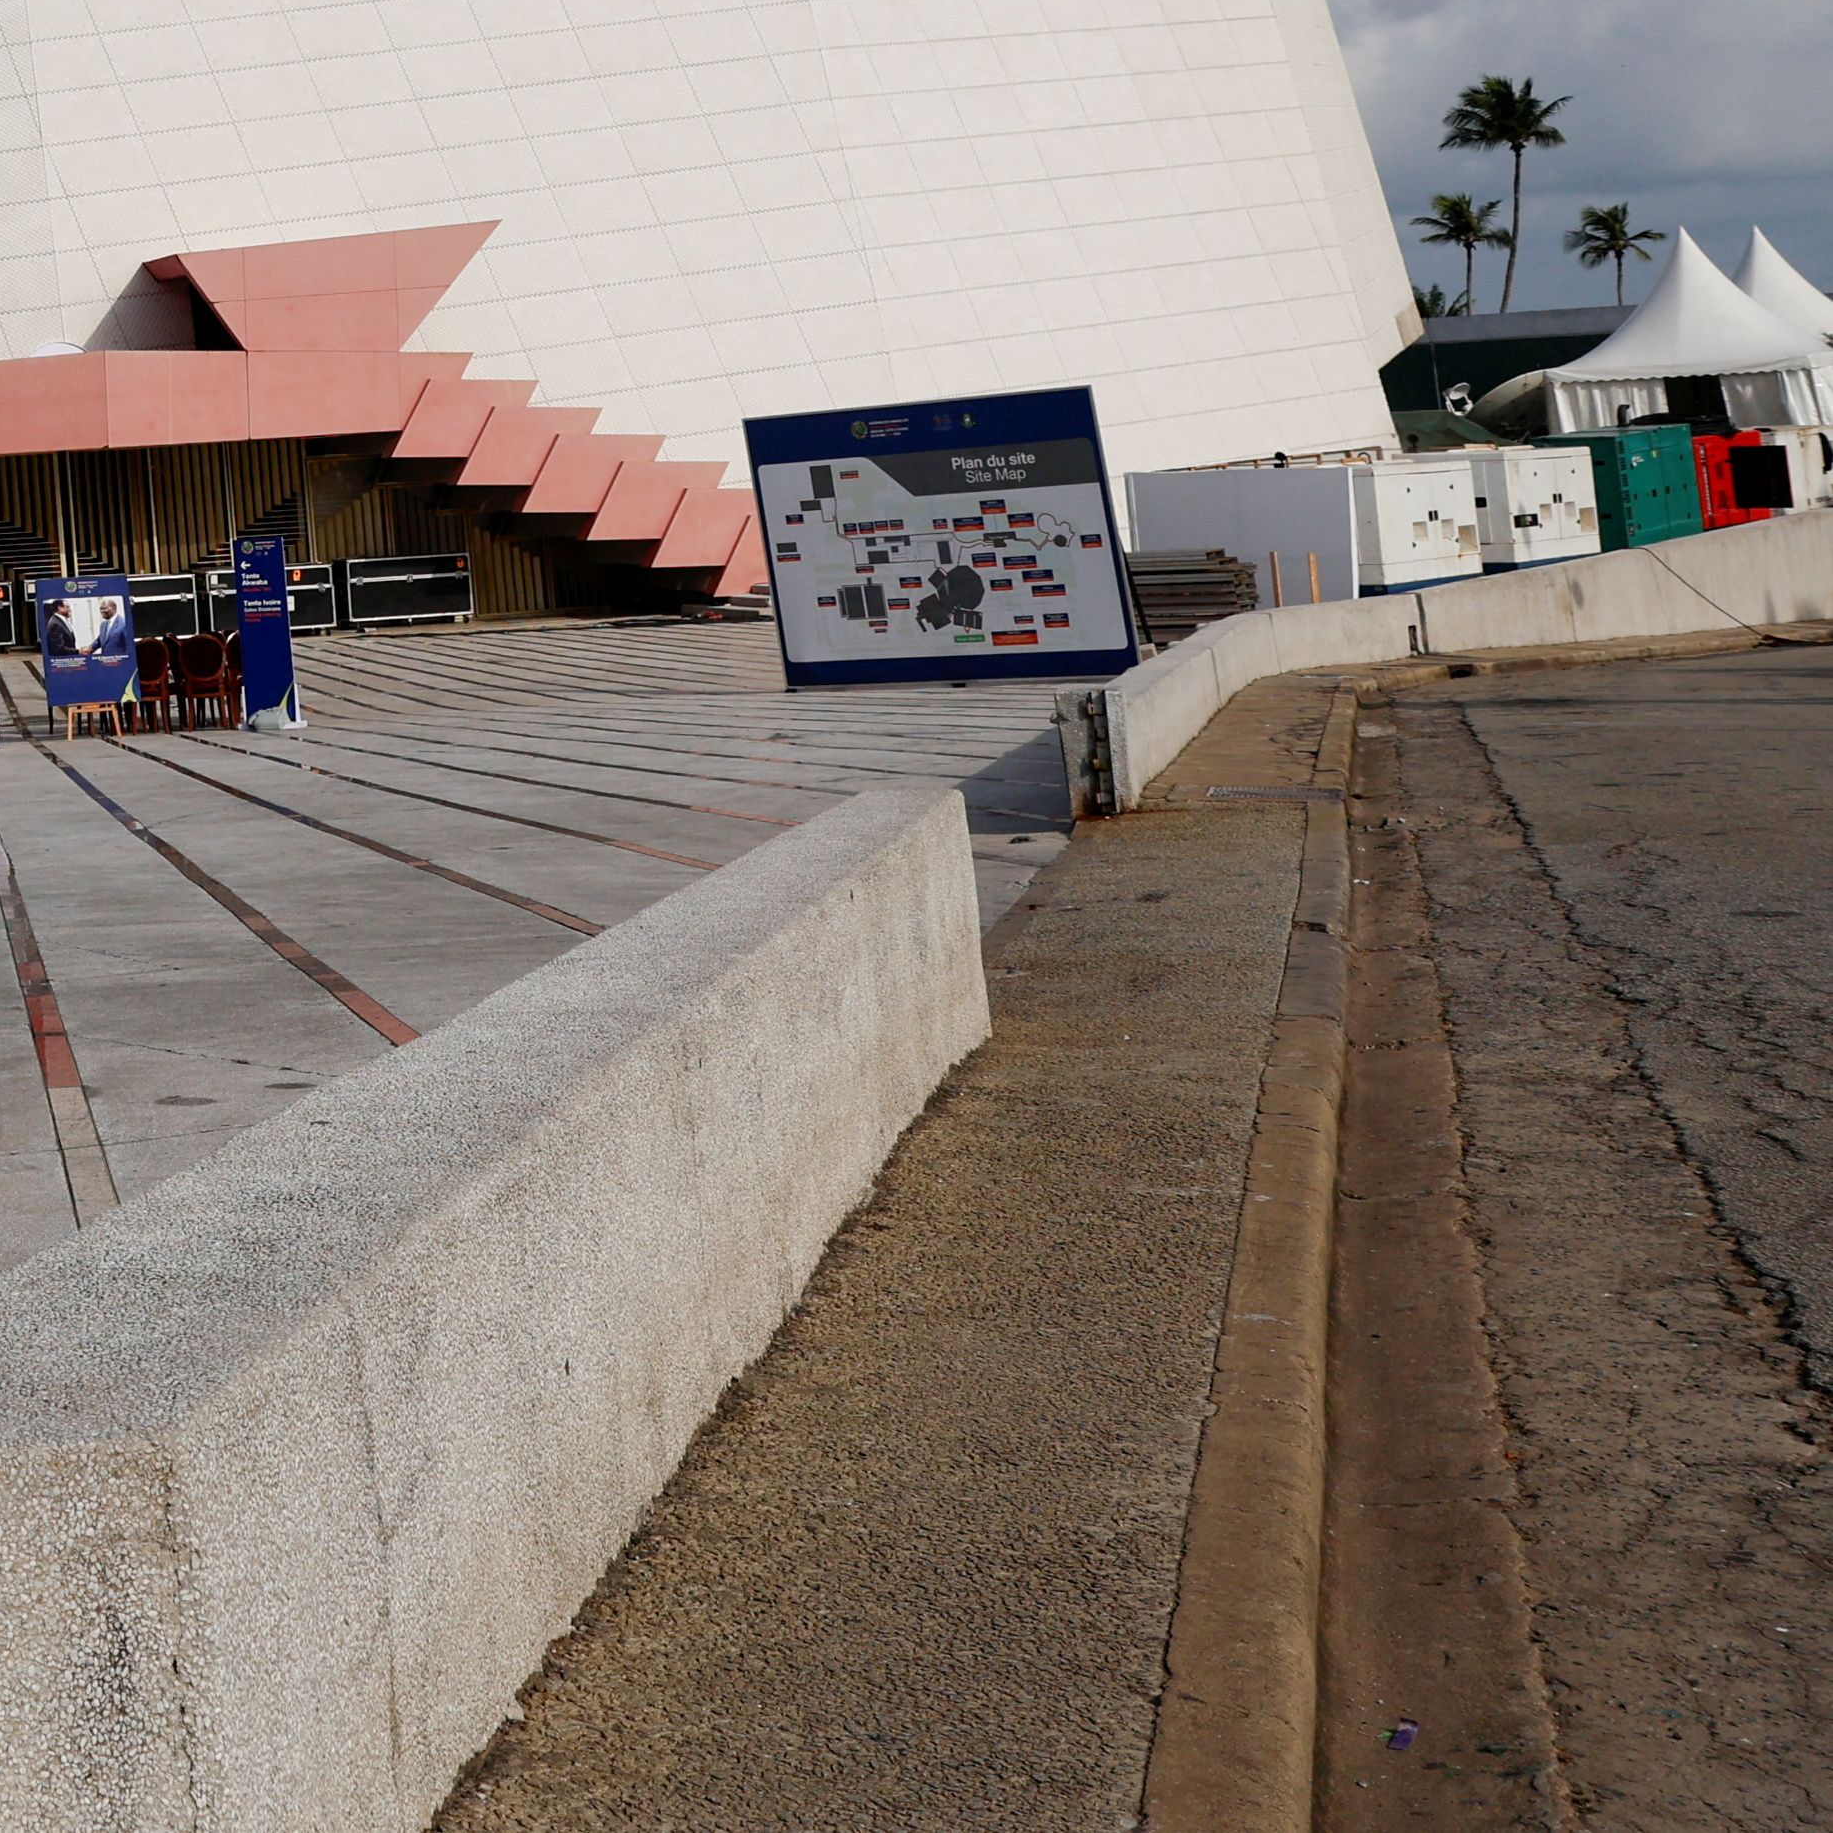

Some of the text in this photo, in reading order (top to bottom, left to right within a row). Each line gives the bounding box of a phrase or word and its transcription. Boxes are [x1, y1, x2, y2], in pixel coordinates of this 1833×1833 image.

[951, 452, 1036, 471] Plan du site
[965, 467, 1027, 484] Site Map
